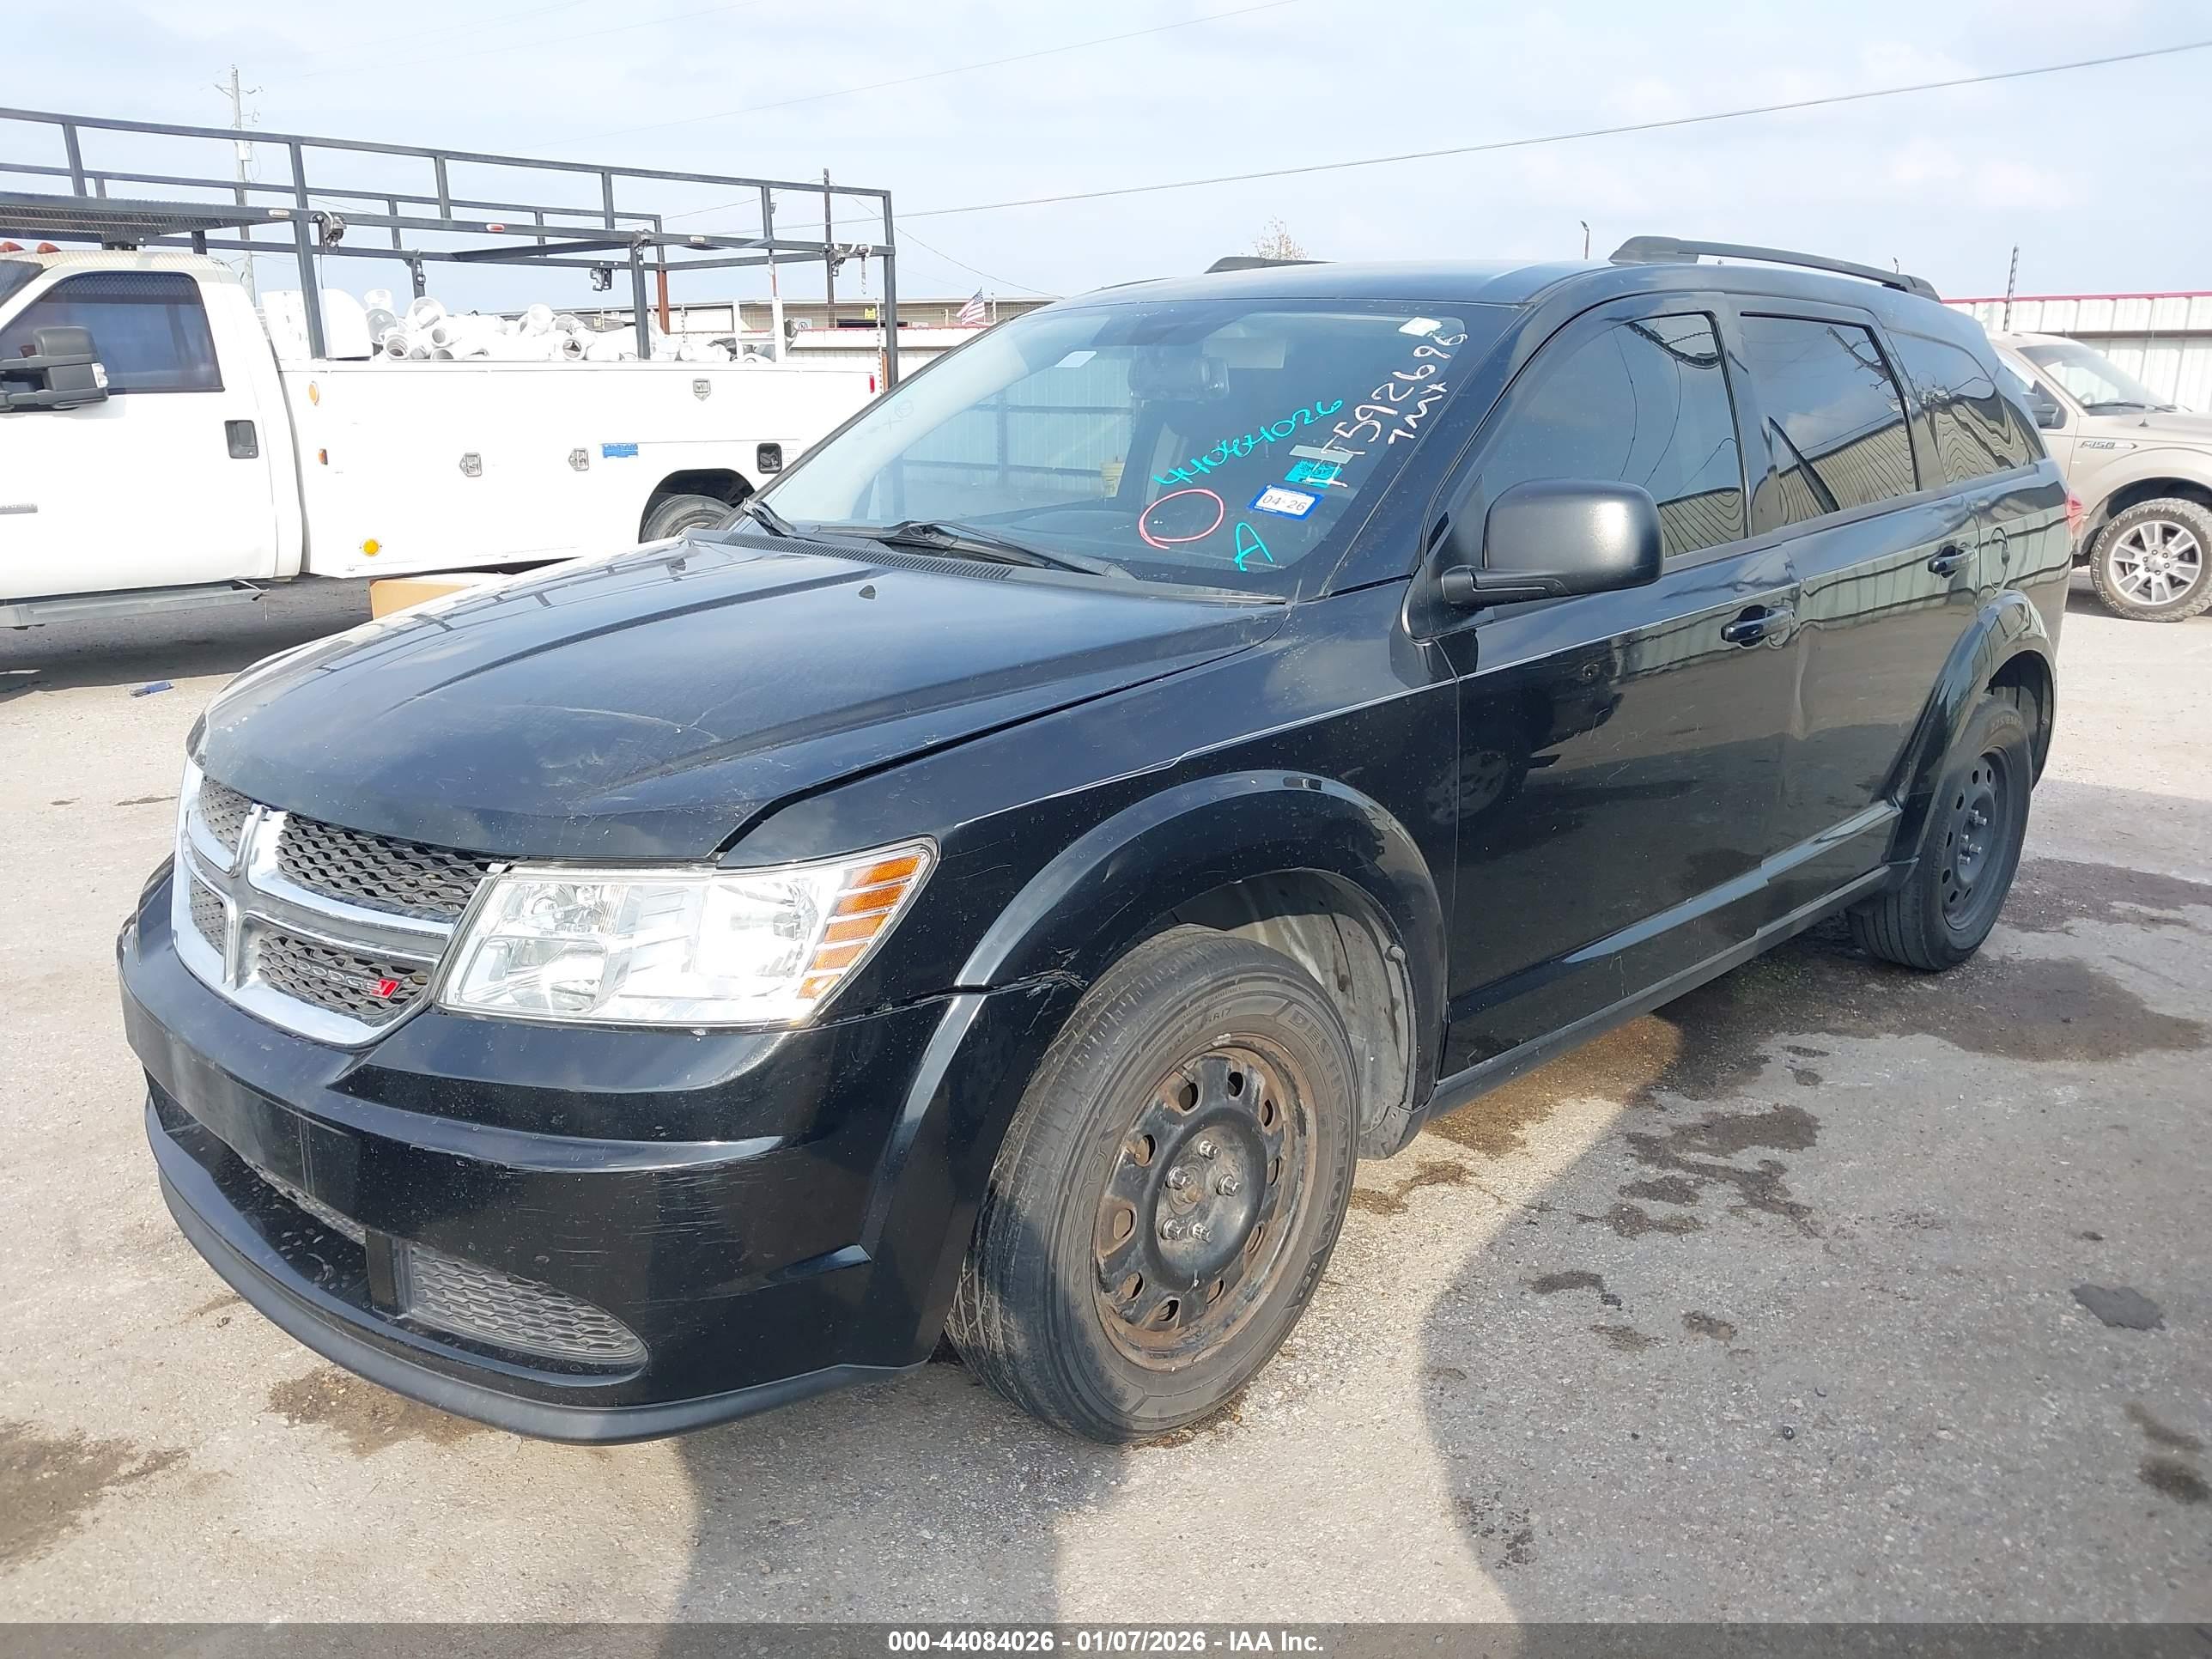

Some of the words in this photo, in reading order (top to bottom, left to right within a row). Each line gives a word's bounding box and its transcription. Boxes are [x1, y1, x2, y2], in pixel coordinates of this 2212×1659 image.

[1152, 398, 1344, 485] 44084026
[1234, 521, 1273, 572] A
[295, 960, 382, 993] DODGE
